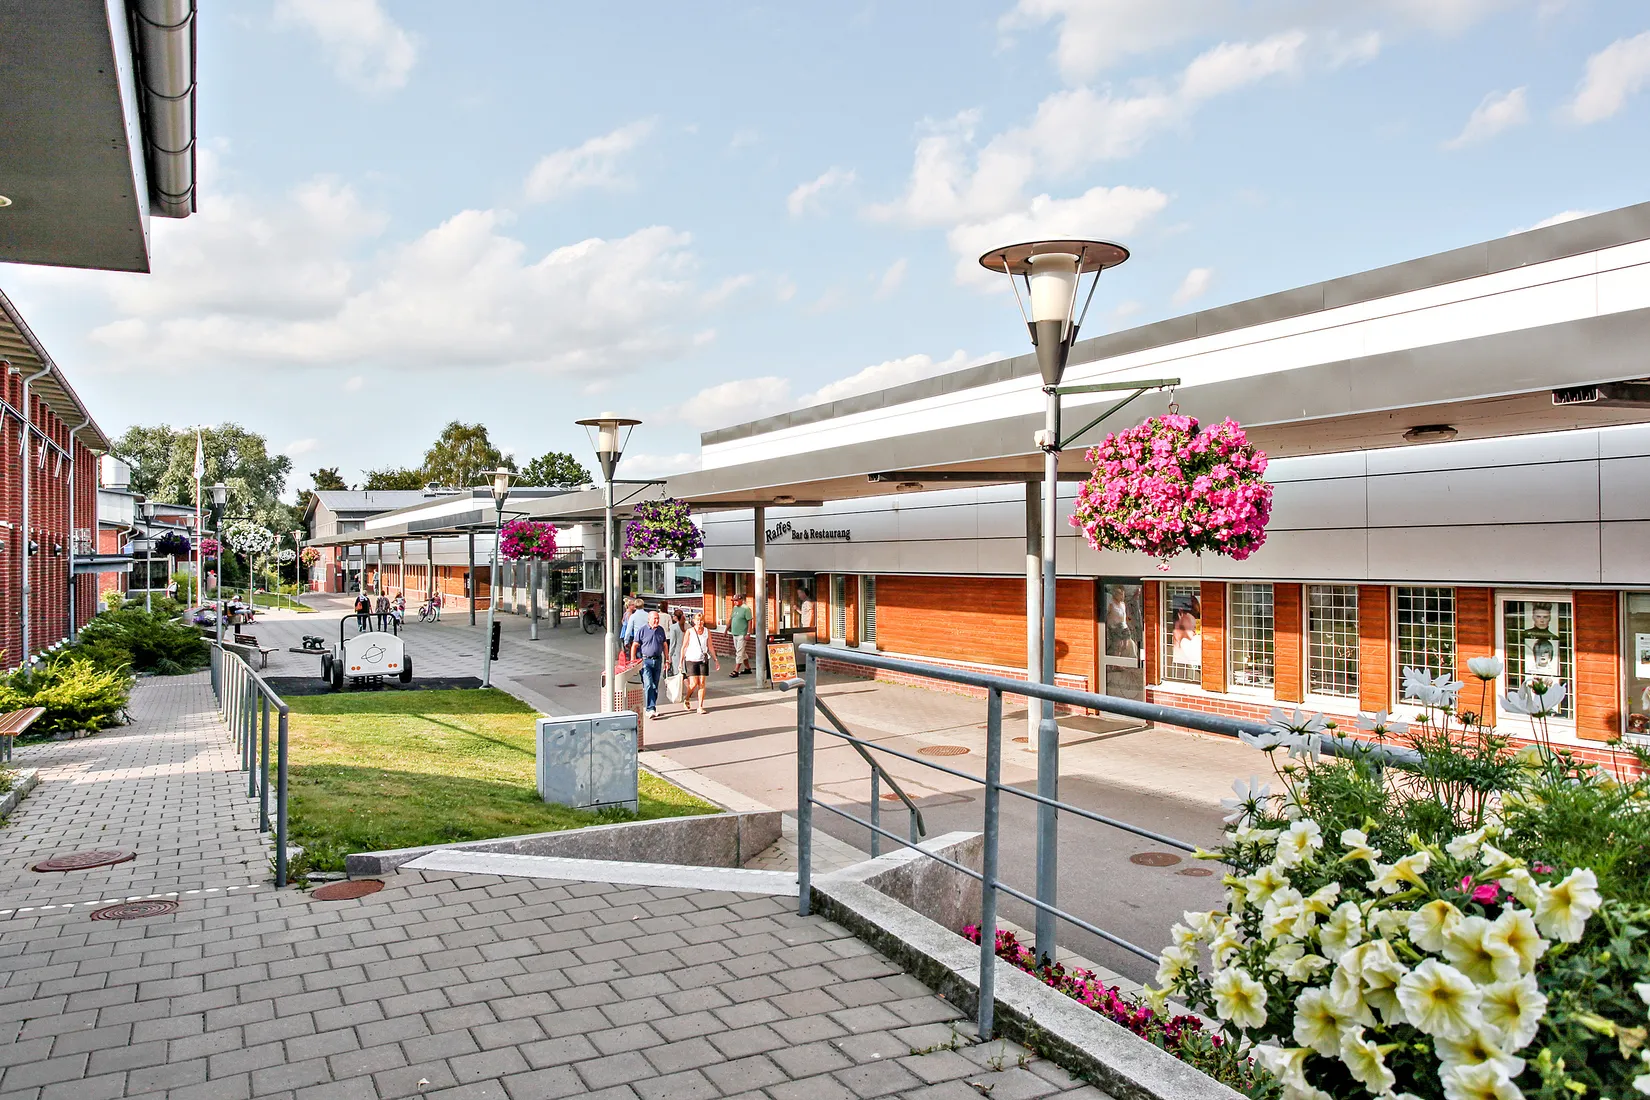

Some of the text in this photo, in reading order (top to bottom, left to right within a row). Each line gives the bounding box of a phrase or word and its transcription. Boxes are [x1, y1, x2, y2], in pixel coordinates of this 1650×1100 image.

[791, 529, 851, 541] Bar & Restaurang
